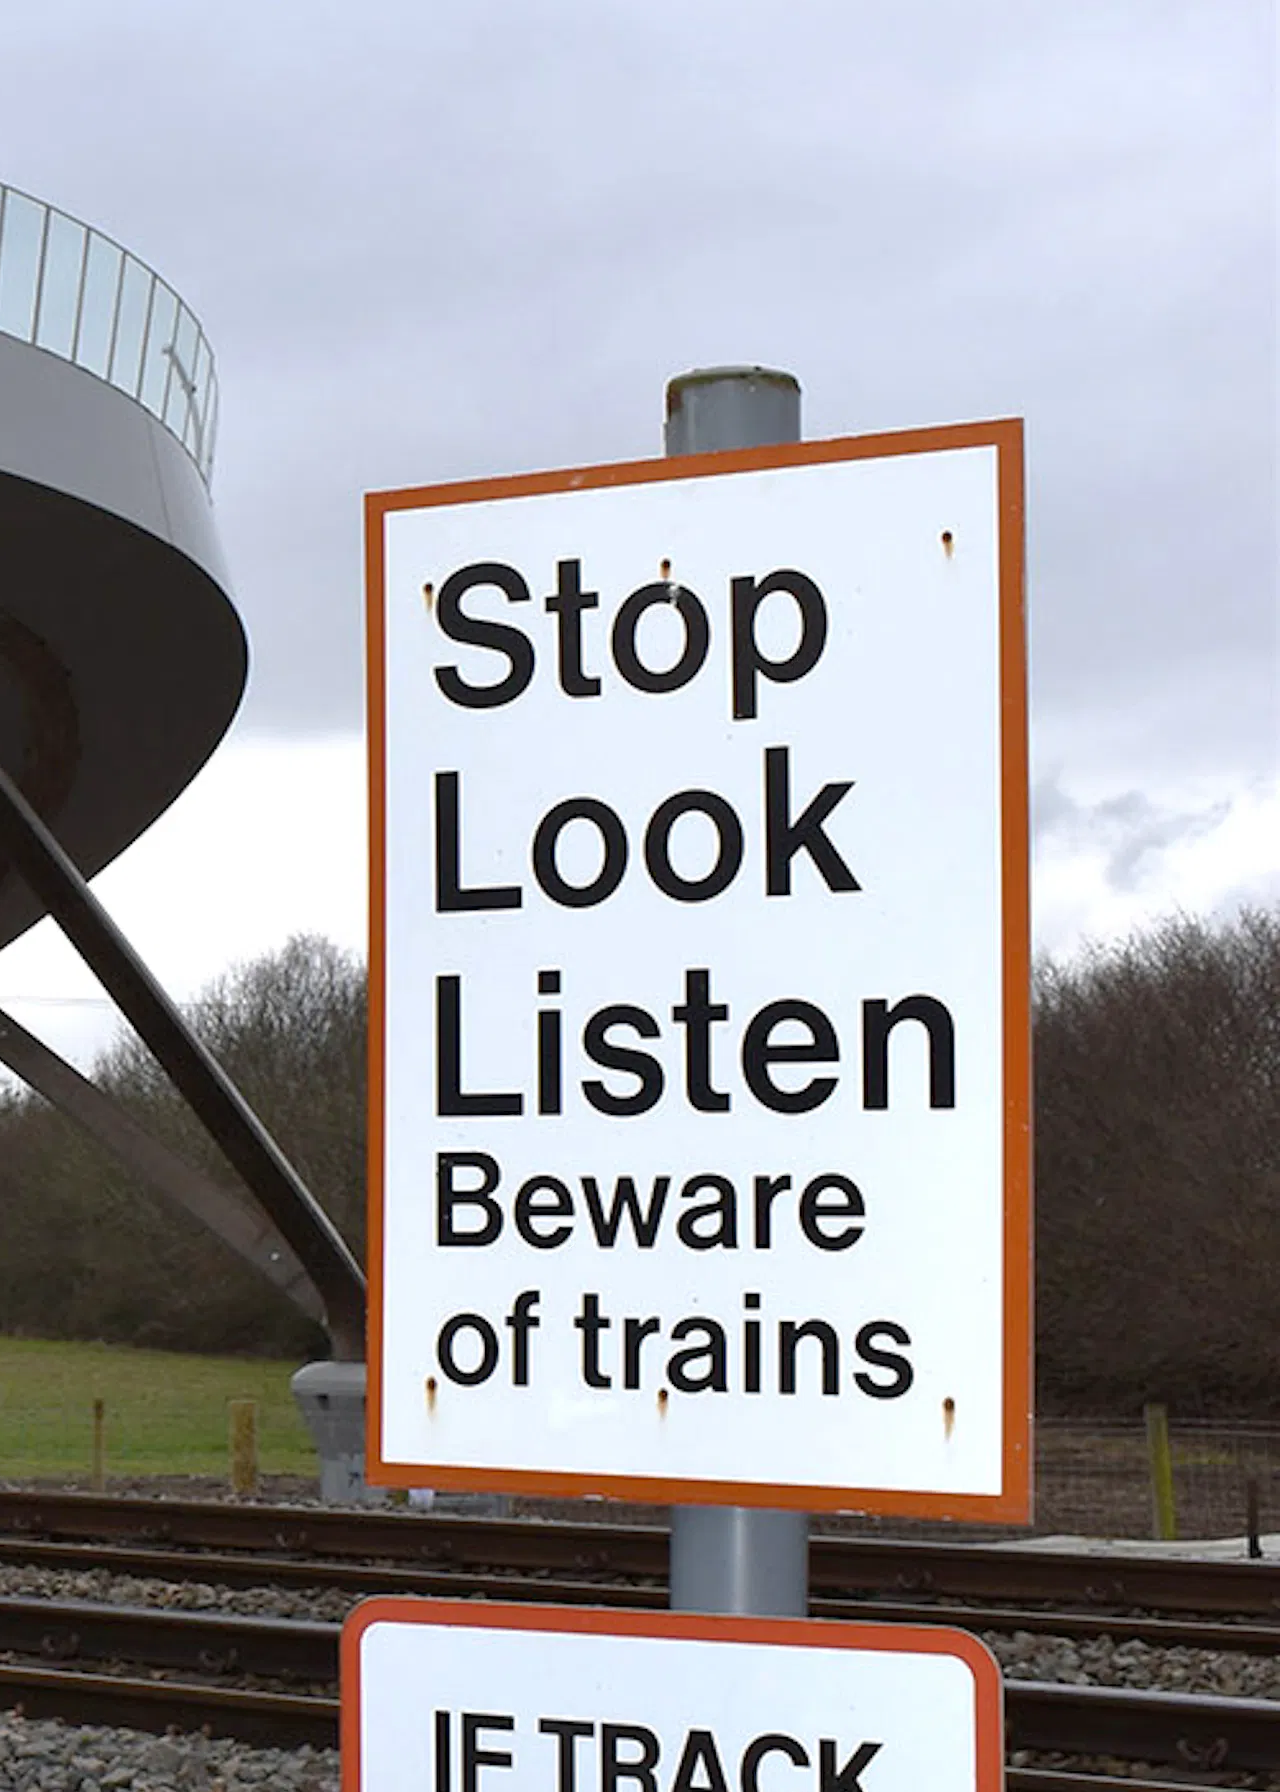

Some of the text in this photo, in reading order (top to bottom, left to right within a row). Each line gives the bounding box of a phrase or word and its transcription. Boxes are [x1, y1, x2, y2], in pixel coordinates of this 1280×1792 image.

[433, 557, 828, 722] Stop
[434, 745, 863, 914] Look
[435, 967, 956, 1118] Listen
[435, 1151, 867, 1253] Beware
[436, 1289, 915, 1400] of trains
